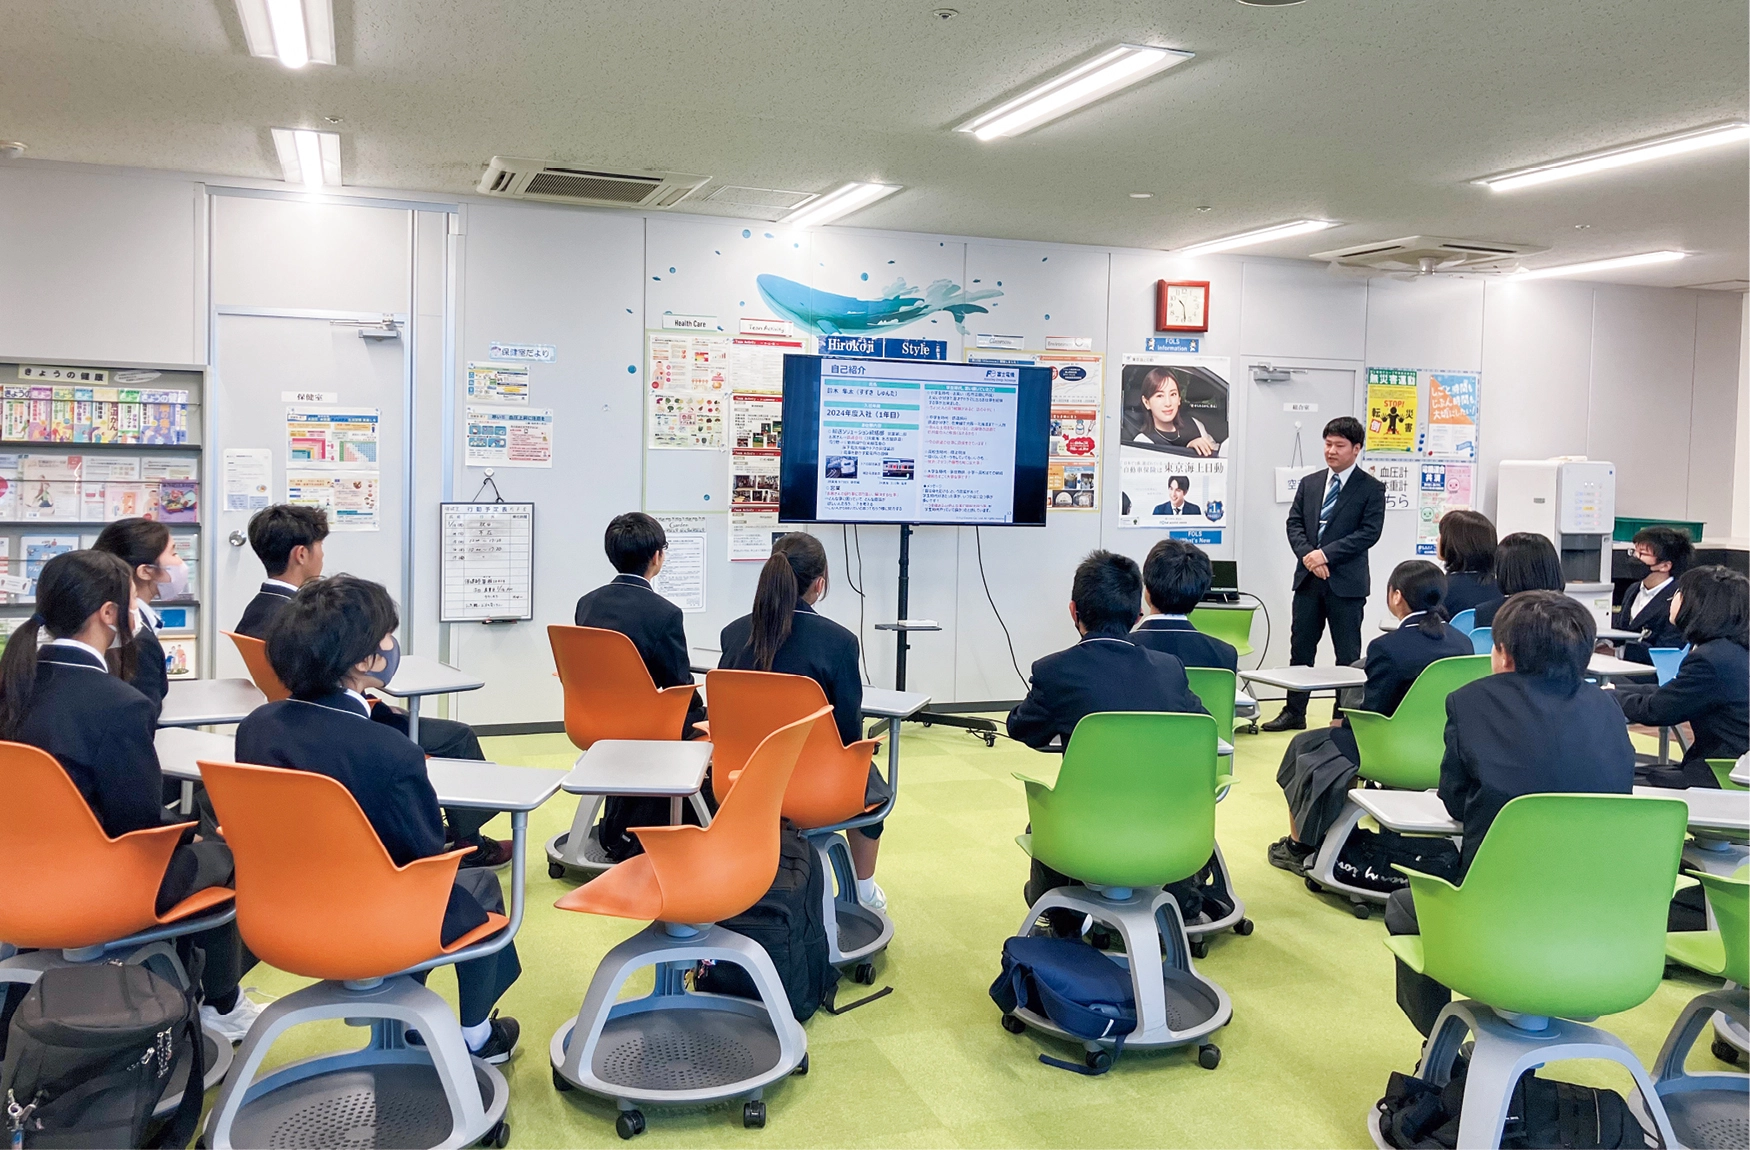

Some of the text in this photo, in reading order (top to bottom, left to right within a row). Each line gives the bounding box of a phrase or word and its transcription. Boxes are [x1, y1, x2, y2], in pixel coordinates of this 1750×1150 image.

[674, 319, 707, 328] Health Care
[749, 323, 763, 331] Team
[501, 347, 550, 358] 保健室だより
[827, 338, 930, 356] Hirokoji Style
[1157, 344, 1188, 352] Information
[24, 367, 104, 382] きょうの健康
[831, 364, 866, 375] 自己紹介
[1369, 373, 1416, 386] 無災害運動
[1431, 380, 1473, 396] しごと時間も
[297, 393, 324, 402] 保健室
[1383, 399, 1405, 408] STOP!
[1431, 394, 1475, 409] じぶん時間も
[1123, 462, 1224, 474] 自動車保険は 東京海上日動
[1380, 466, 1409, 479] 血圧計
[1385, 494, 1410, 508] ちら
